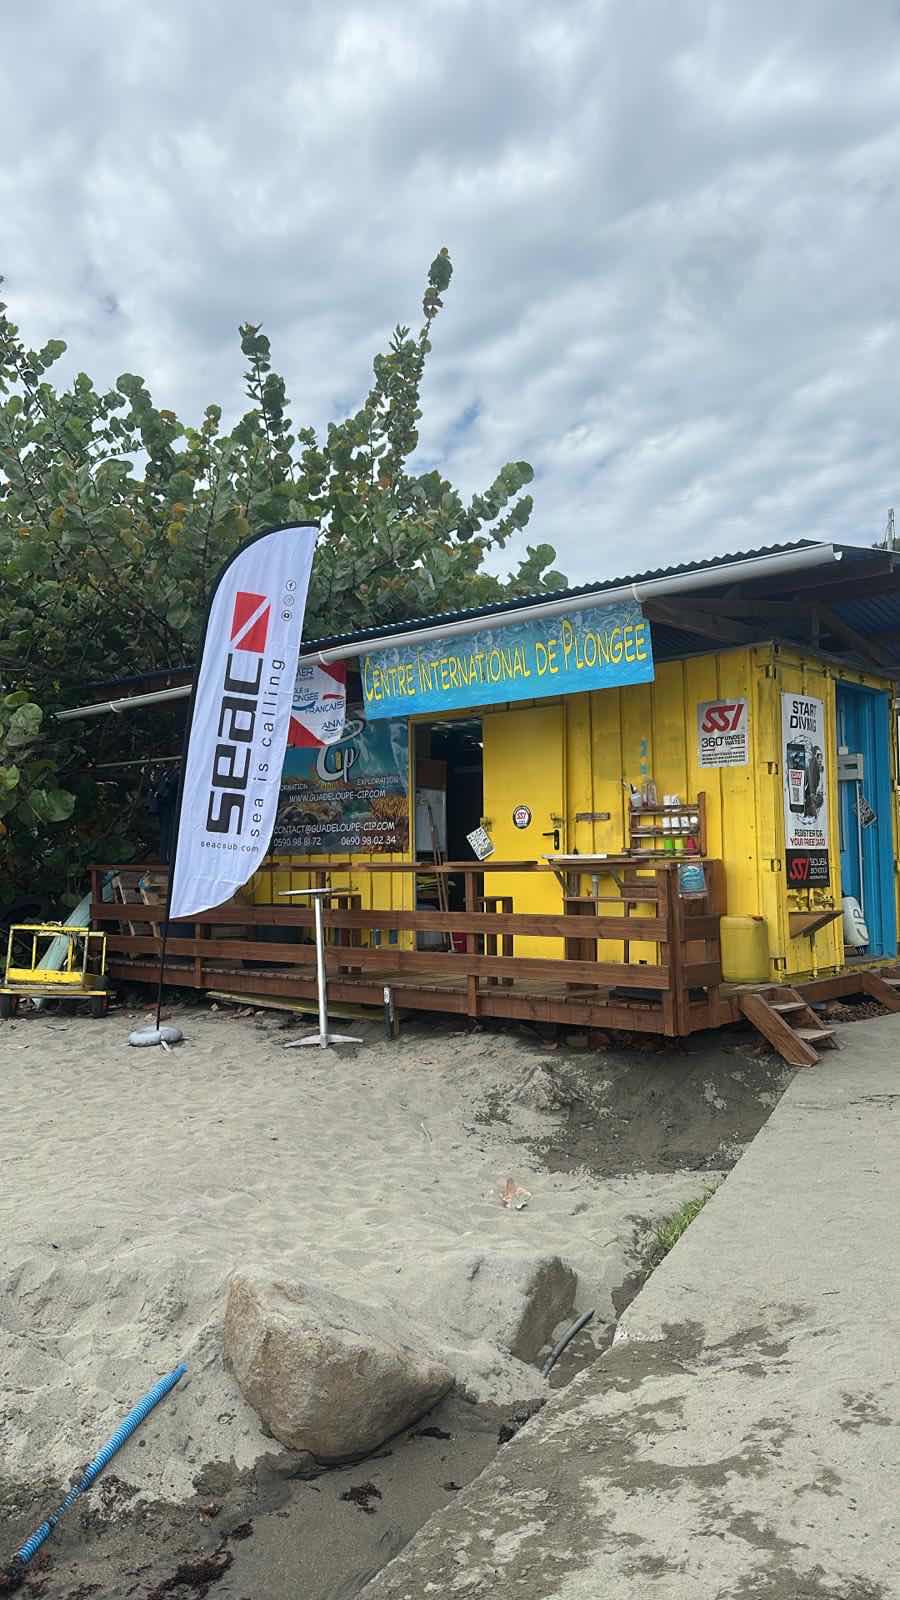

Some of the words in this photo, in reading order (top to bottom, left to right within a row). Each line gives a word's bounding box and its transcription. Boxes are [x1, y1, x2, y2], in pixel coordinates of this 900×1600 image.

[363, 656, 416, 702] CENTRE
[416, 648, 532, 693] INTERNATIONAL
[535, 638, 559, 676] DE
[261, 657, 286, 748] calling
[701, 703, 745, 733] SSI
[792, 700, 817, 718] START
[252, 762, 270, 782] is
[250, 797, 265, 838] sea
